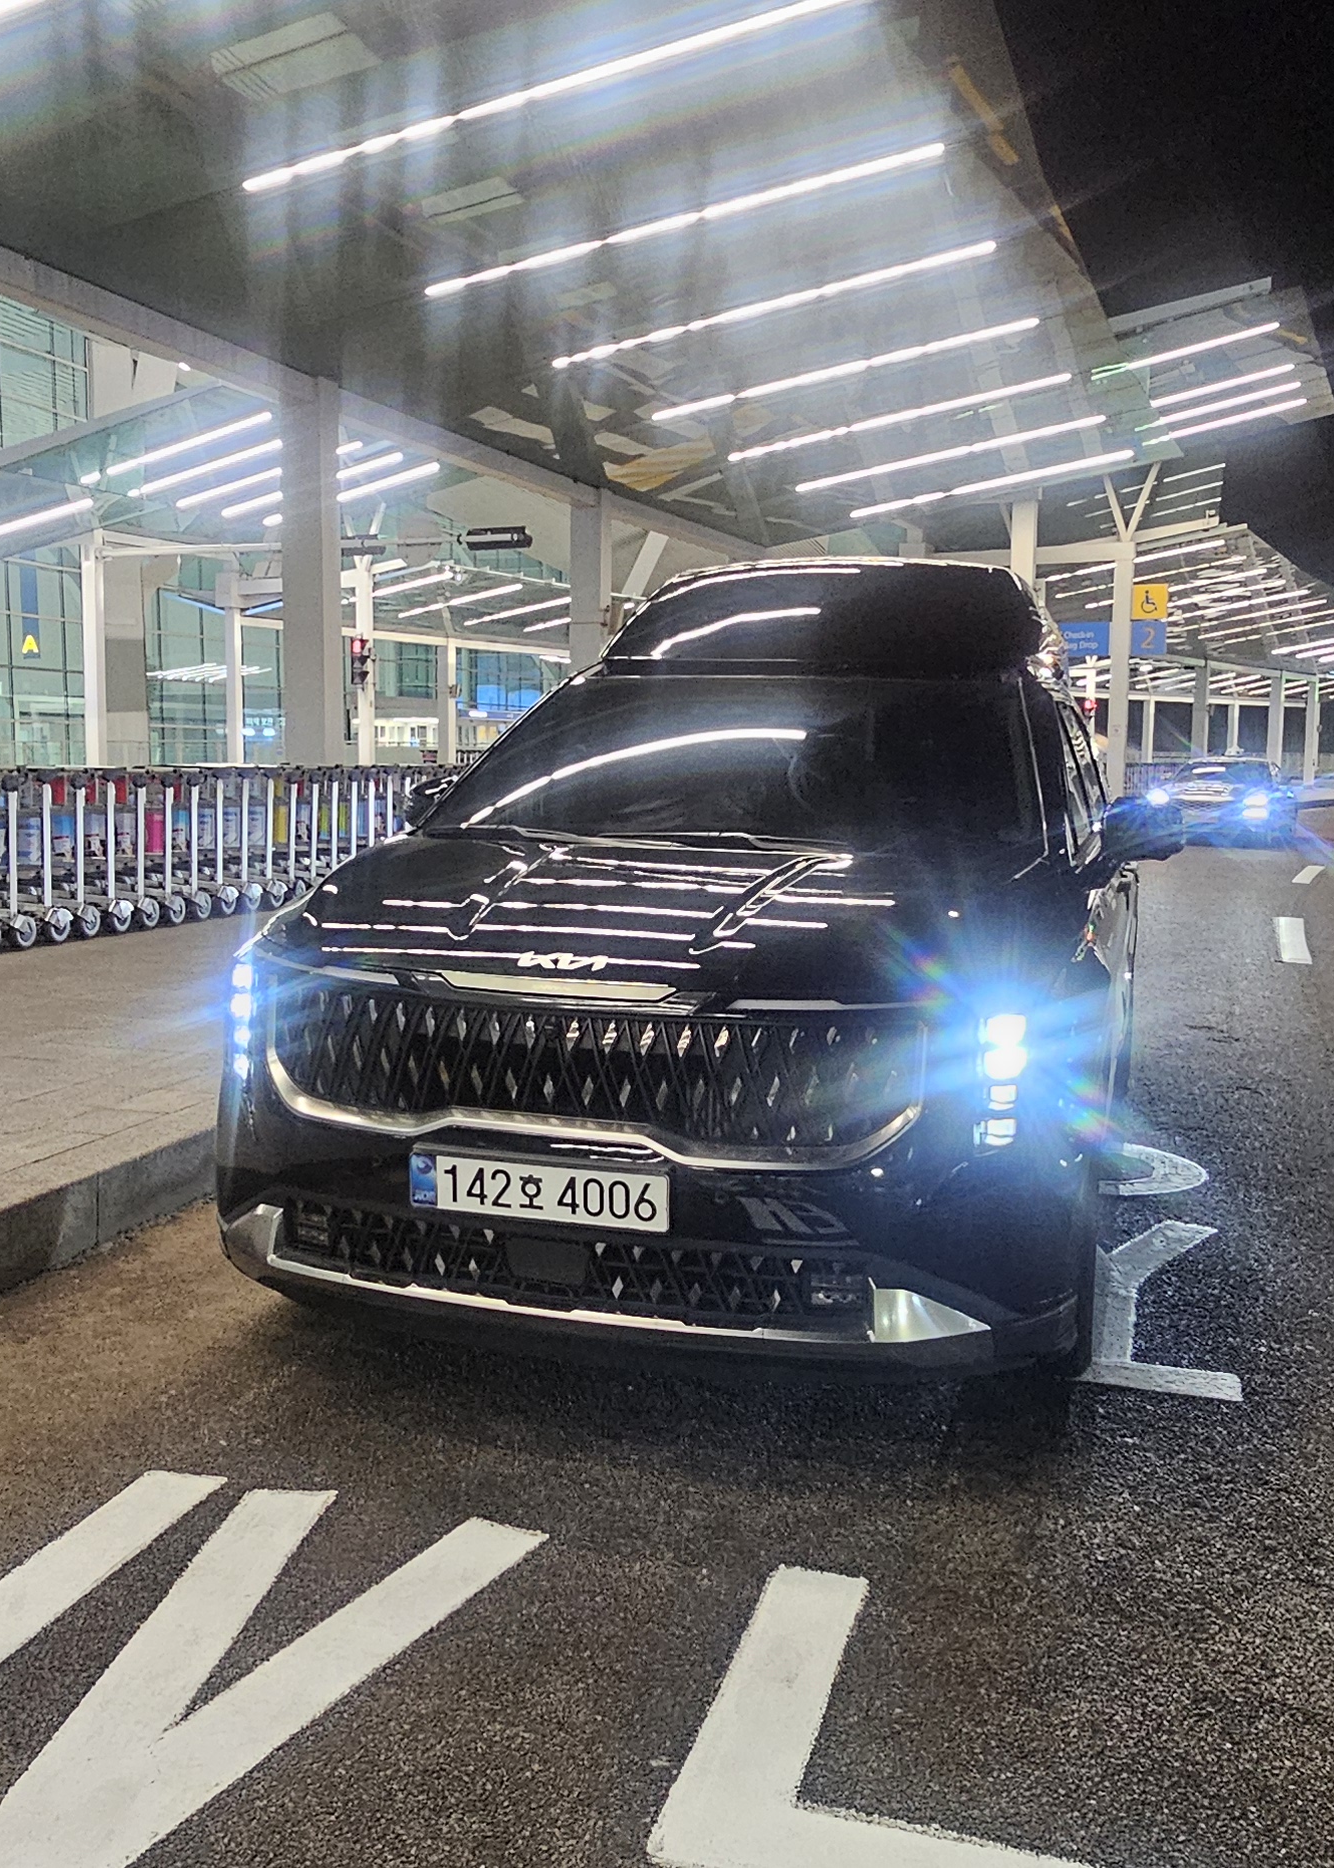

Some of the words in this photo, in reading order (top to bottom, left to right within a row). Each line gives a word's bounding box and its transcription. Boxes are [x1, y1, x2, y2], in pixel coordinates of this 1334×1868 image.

[21, 634, 39, 654] A
[1141, 627, 1155, 648] 2
[443, 1163, 544, 1211] 142호
[557, 1176, 657, 1222] 4006
